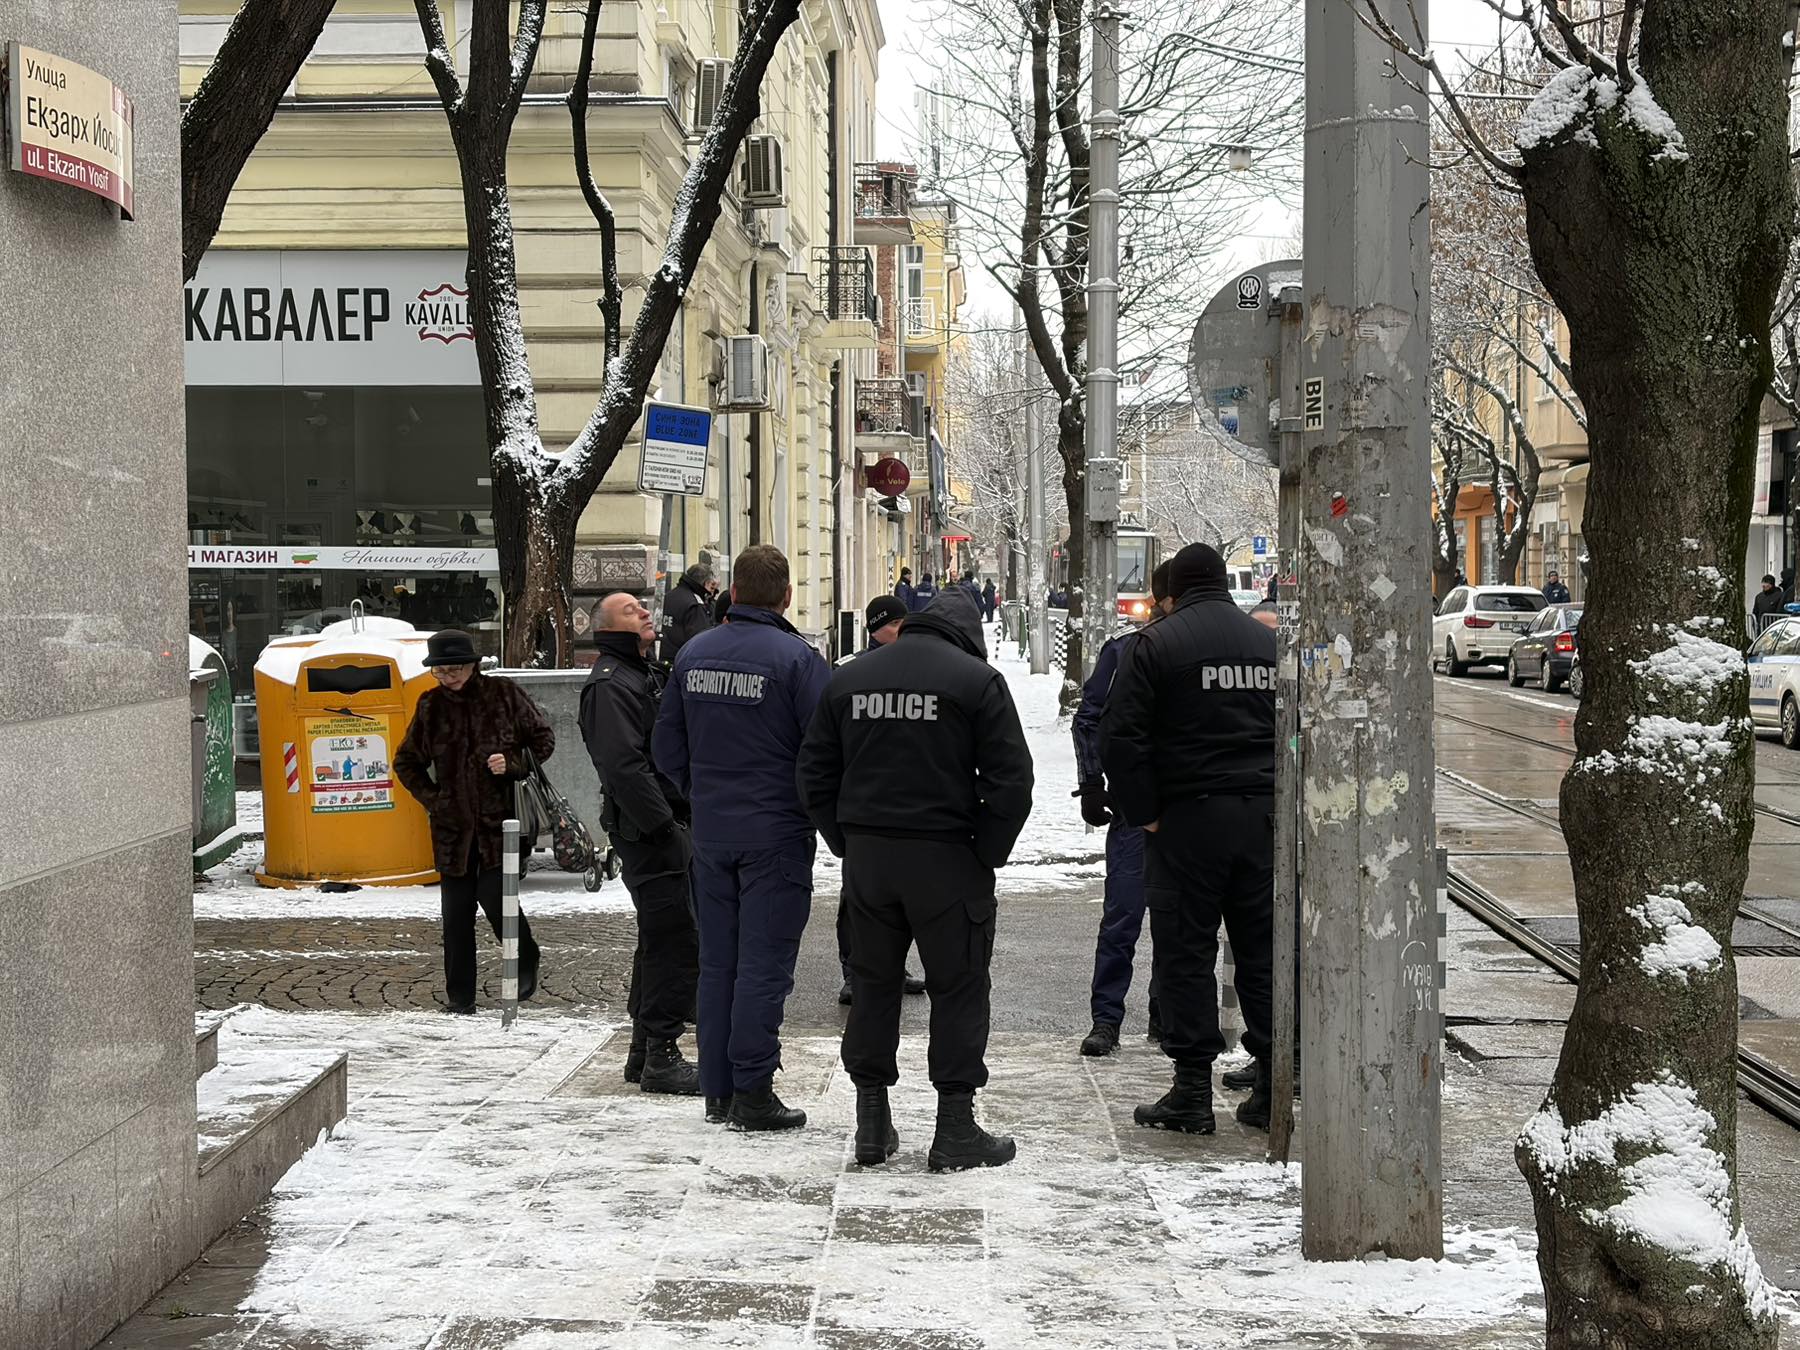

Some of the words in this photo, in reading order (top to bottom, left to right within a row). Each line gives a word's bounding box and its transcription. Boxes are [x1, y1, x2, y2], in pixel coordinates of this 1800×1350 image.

[26, 58, 66, 91] Улица
[26, 96, 89, 144] Екзарх
[27, 148, 45, 170] ul.
[48, 152, 86, 183] Ekzarh
[88, 164, 109, 191] Yosif
[184, 288, 390, 341] КАВАЛЕР
[1305, 381, 1322, 428] BNE
[201, 550, 278, 563] МАГАЗИН
[686, 669, 731, 697] SECURITY
[731, 671, 765, 698] POLICE
[1201, 665, 1276, 690] POLICE
[852, 693, 938, 721] POLICE
